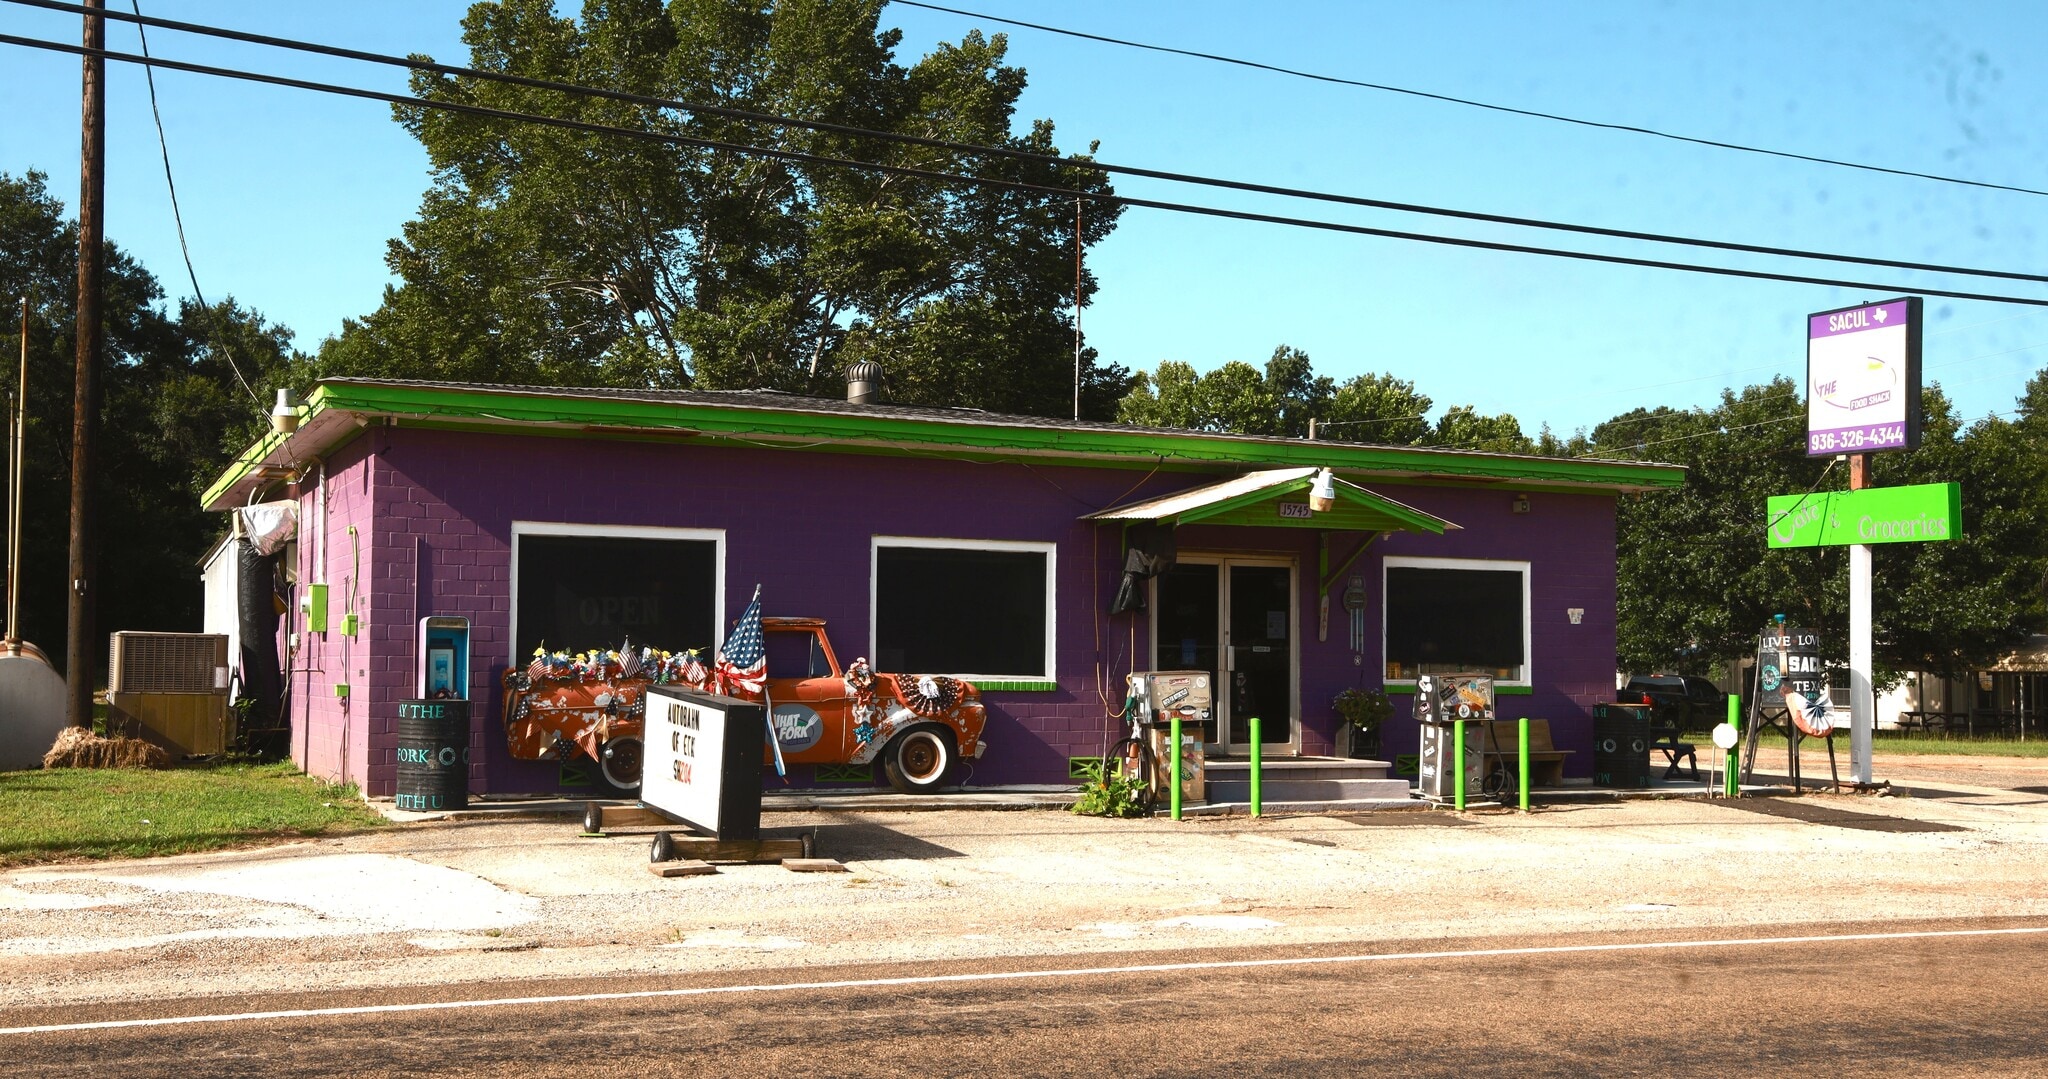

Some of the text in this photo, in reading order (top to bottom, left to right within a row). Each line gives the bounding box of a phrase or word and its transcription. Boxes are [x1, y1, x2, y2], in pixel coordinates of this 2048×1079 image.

[1829, 310, 1870, 332] SACUL
[1818, 380, 1837, 398] THE
[1851, 391, 1890, 410] FOOD SHACK
[1811, 426, 1904, 451] 936-326-4344
[1281, 503, 1309, 516] 15745
[1858, 512, 1947, 540] Groceries
[1762, 636, 1791, 648] LIVE
[411, 704, 445, 719] THE
[668, 702, 700, 731] AUTOBAHN
[671, 730, 680, 753] OF
[779, 725, 808, 741] FORK
[431, 795, 444, 809] U
